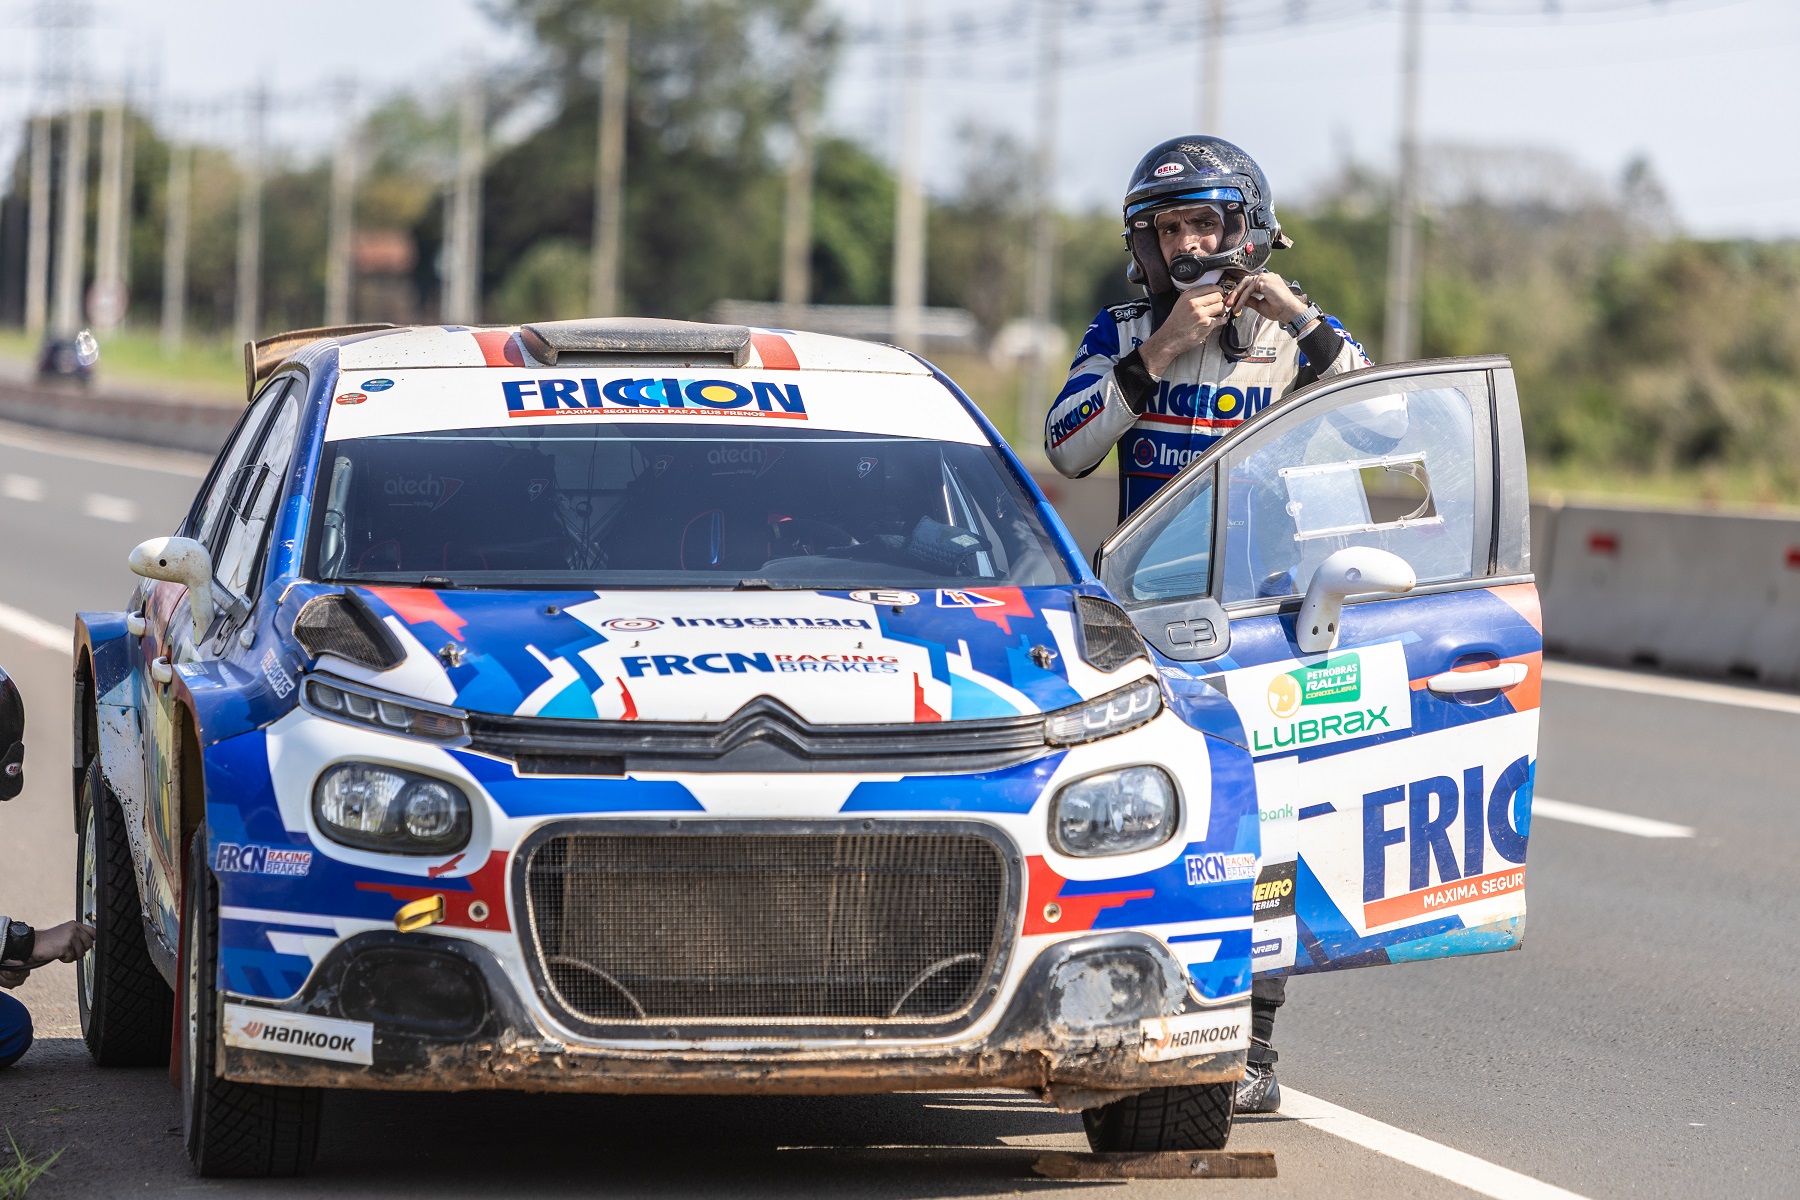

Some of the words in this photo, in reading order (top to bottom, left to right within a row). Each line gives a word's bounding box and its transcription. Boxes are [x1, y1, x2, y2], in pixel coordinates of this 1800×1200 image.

[1157, 165, 1179, 174] BELL
[1115, 308, 1137, 318] OMP
[501, 378, 806, 413] FRICCION
[384, 473, 440, 496] atech
[671, 616, 873, 630] Ingemaq
[1165, 618, 1217, 650] C3
[620, 652, 775, 678] FRCN
[774, 654, 899, 663] RACING
[778, 662, 899, 674] BRAKES
[1307, 664, 1357, 680] PETROBRAS
[1306, 673, 1357, 692] RALLY
[1306, 685, 1357, 699] CORDILLERA
[217, 845, 267, 872] FRCN
[268, 851, 311, 863] RACING
[1225, 856, 1255, 866] RACING
[266, 863, 308, 875] BRAKES
[1187, 856, 1226, 882] FRCN
[1227, 867, 1256, 879] BRAKES
[1423, 884, 1478, 909] MAXIMA
[1481, 872, 1525, 895] SEGUR
